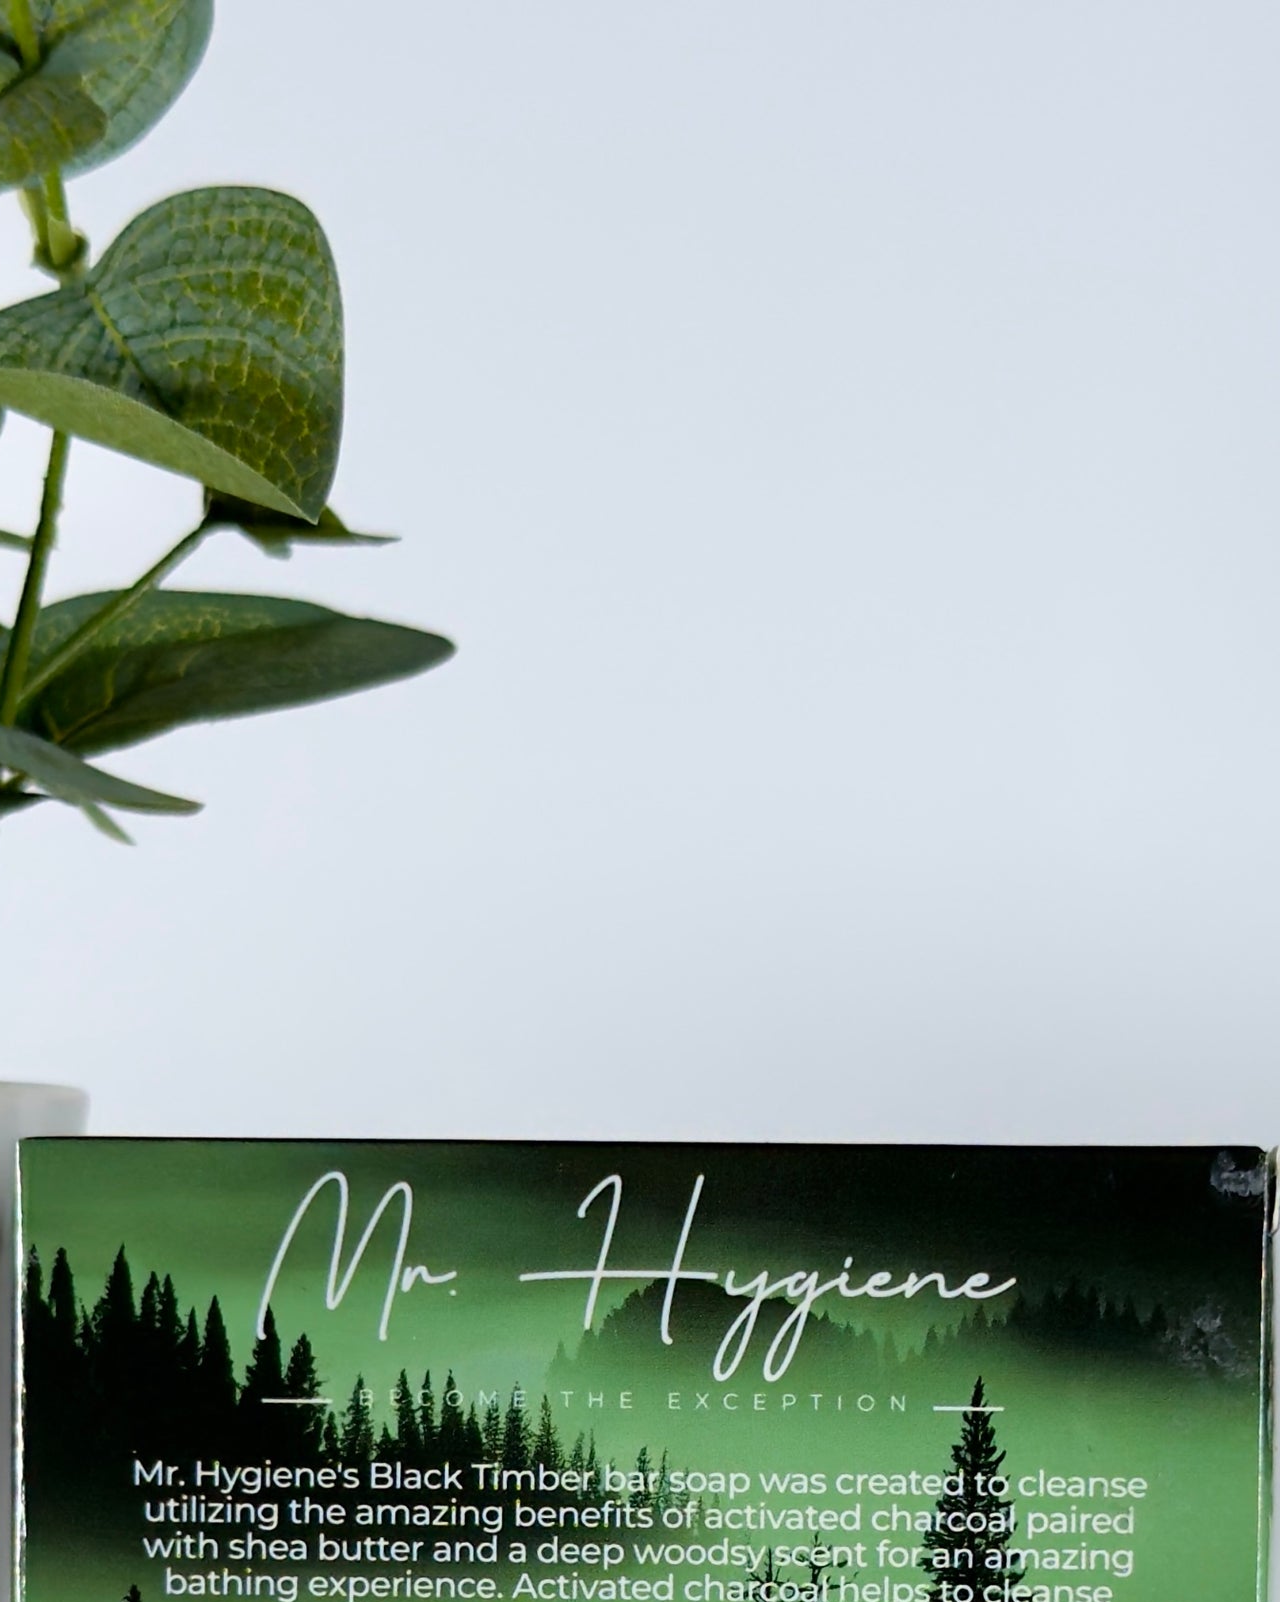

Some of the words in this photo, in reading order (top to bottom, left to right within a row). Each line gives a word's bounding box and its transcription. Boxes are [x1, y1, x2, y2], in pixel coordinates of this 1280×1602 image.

[257, 1172, 457, 1341] Mr.
[519, 1173, 1018, 1382] Hygiene
[560, 1391, 632, 1409] THE
[668, 1392, 907, 1412] EXCEPTION
[134, 1460, 185, 1487] Mr.
[196, 1460, 359, 1494] Hygiene's
[371, 1462, 462, 1489] Black
[471, 1464, 594, 1492] Timber
[605, 1465, 659, 1492] bar
[669, 1472, 750, 1499] soap
[759, 1472, 827, 1494] was
[836, 1469, 964, 1496] created
[974, 1474, 1009, 1497] to
[1019, 1470, 1148, 1498] cleanse
[145, 1495, 279, 1530] utilizing
[289, 1498, 346, 1524] the
[356, 1498, 502, 1533] amazing
[516, 1499, 653, 1528] benefits
[662, 1501, 696, 1529] of
[704, 1502, 861, 1531] activated
[872, 1504, 1015, 1532] charcoal
[1028, 1505, 1134, 1539] paired
[143, 1531, 218, 1559] with
[229, 1532, 307, 1560] shea
[319, 1534, 423, 1561] butter
[433, 1536, 498, 1562] and
[509, 1543, 526, 1563] a
[537, 1536, 624, 1569] deep
[634, 1538, 766, 1571] woodsy
[774, 1542, 867, 1567] scent
[877, 1540, 922, 1567] for
[932, 1548, 973, 1569] an
[984, 1543, 1134, 1577] amazing
[166, 1568, 298, 1602] bathing
[308, 1569, 502, 1602] experience.
[512, 1572, 673, 1600] Activated
[684, 1574, 829, 1602] charcoal
